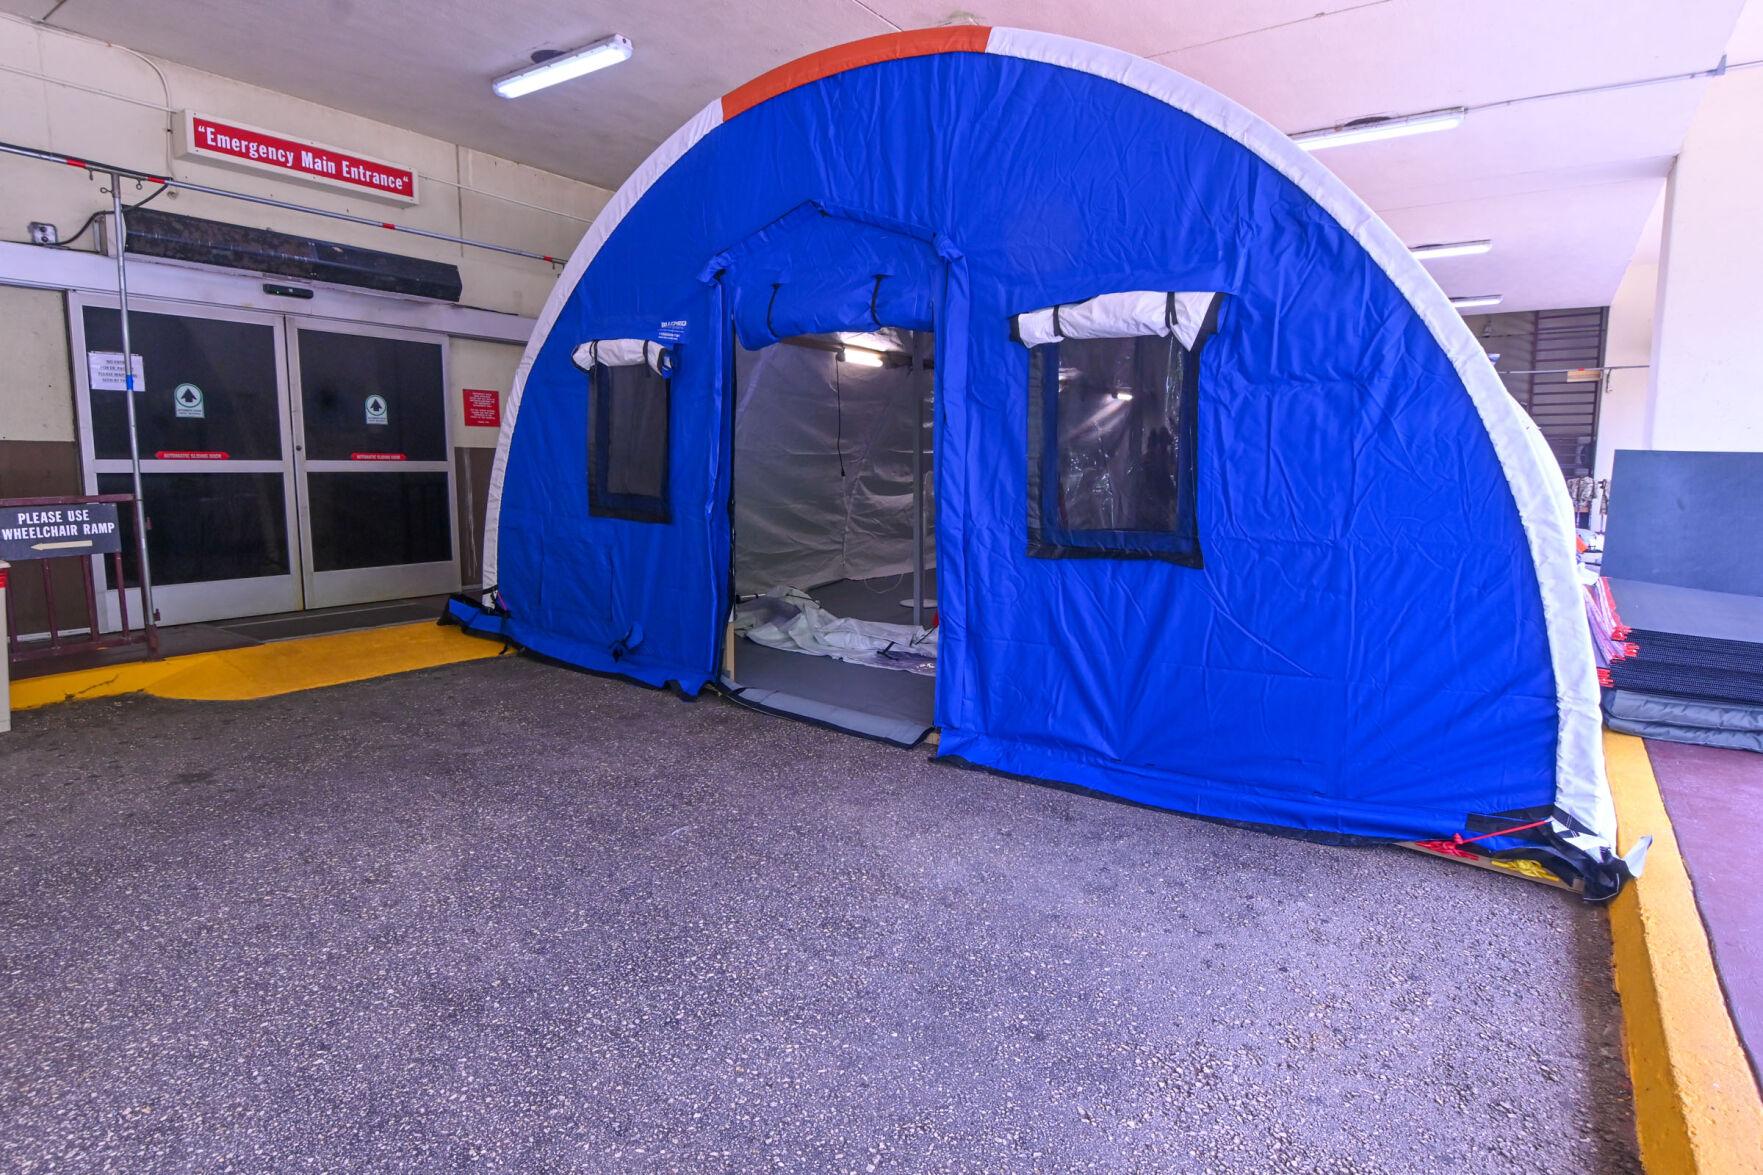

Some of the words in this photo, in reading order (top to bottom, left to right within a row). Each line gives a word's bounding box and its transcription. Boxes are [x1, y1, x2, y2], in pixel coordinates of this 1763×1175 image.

[301, 152, 336, 174] Main
[17, 511, 63, 525] PLEASE
[67, 509, 90, 522] USE
[2, 525, 78, 540] WHEELCHAIR
[83, 522, 115, 535] RAMP
